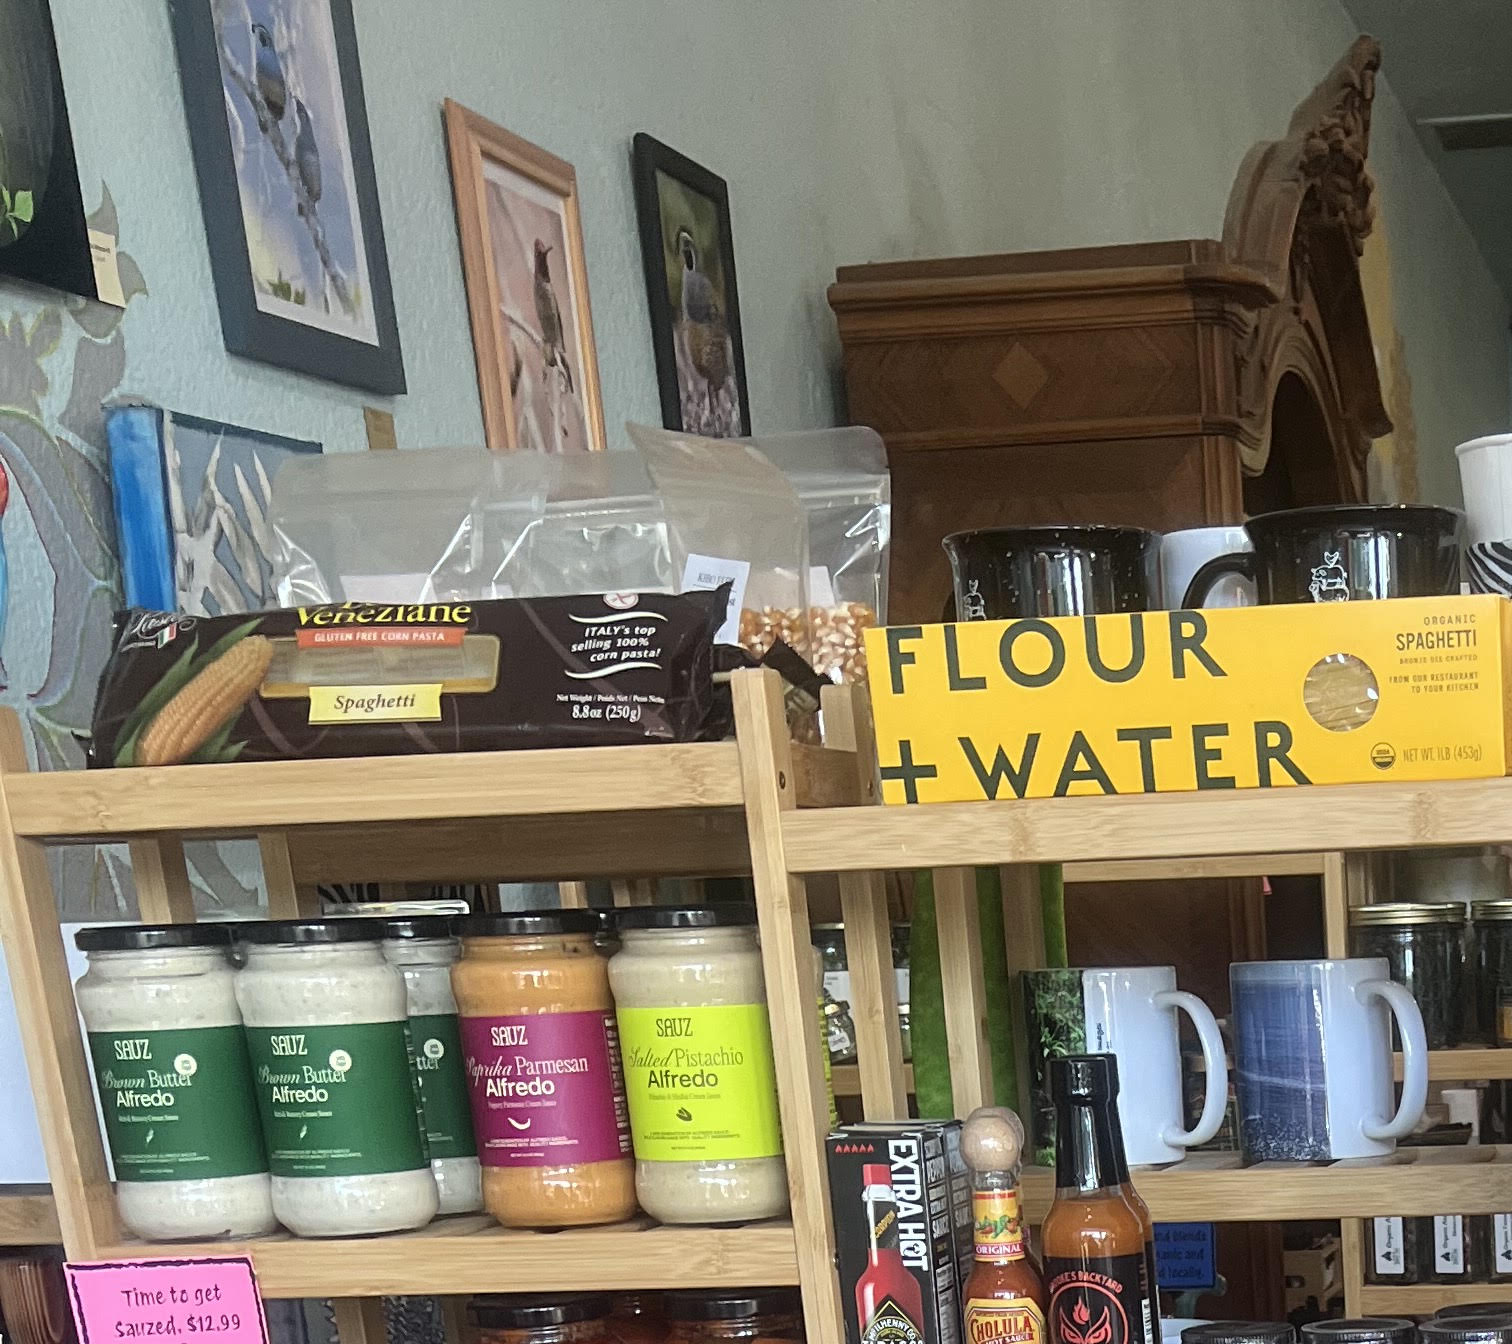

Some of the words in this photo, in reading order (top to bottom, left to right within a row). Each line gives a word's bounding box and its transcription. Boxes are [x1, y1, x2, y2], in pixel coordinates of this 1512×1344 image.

[1423, 614, 1476, 627] ORGANIC
[313, 631, 353, 644] GLUTEN
[355, 631, 379, 643] FREE
[381, 631, 410, 643] CORN
[412, 631, 446, 643] PASTA
[634, 625, 657, 639] top
[1395, 628, 1478, 652] SPAGHETTI
[571, 638, 612, 653] selling
[616, 636, 650, 649] 100%
[885, 610, 1228, 696] FLOUR
[589, 651, 618, 663] corn
[620, 647, 662, 664] pasta!
[333, 693, 416, 714] Spaghetti
[957, 721, 1313, 801] WATER
[271, 1035, 308, 1056] SAUZ
[515, 1055, 589, 1078] Parmesan
[675, 1047, 744, 1070] Pistachio
[303, 1065, 347, 1084] Butter
[647, 1069, 719, 1090] Alfredo
[272, 1085, 329, 1104] Alfredo
[887, 1139, 921, 1219] EXTRA
[897, 1223, 929, 1273] HOT
[121, 1287, 165, 1307] Time
[169, 1286, 189, 1304] to
[194, 1283, 222, 1306] get
[187, 1314, 241, 1333] $12.99
[970, 1315, 1036, 1344] CHOLULA
